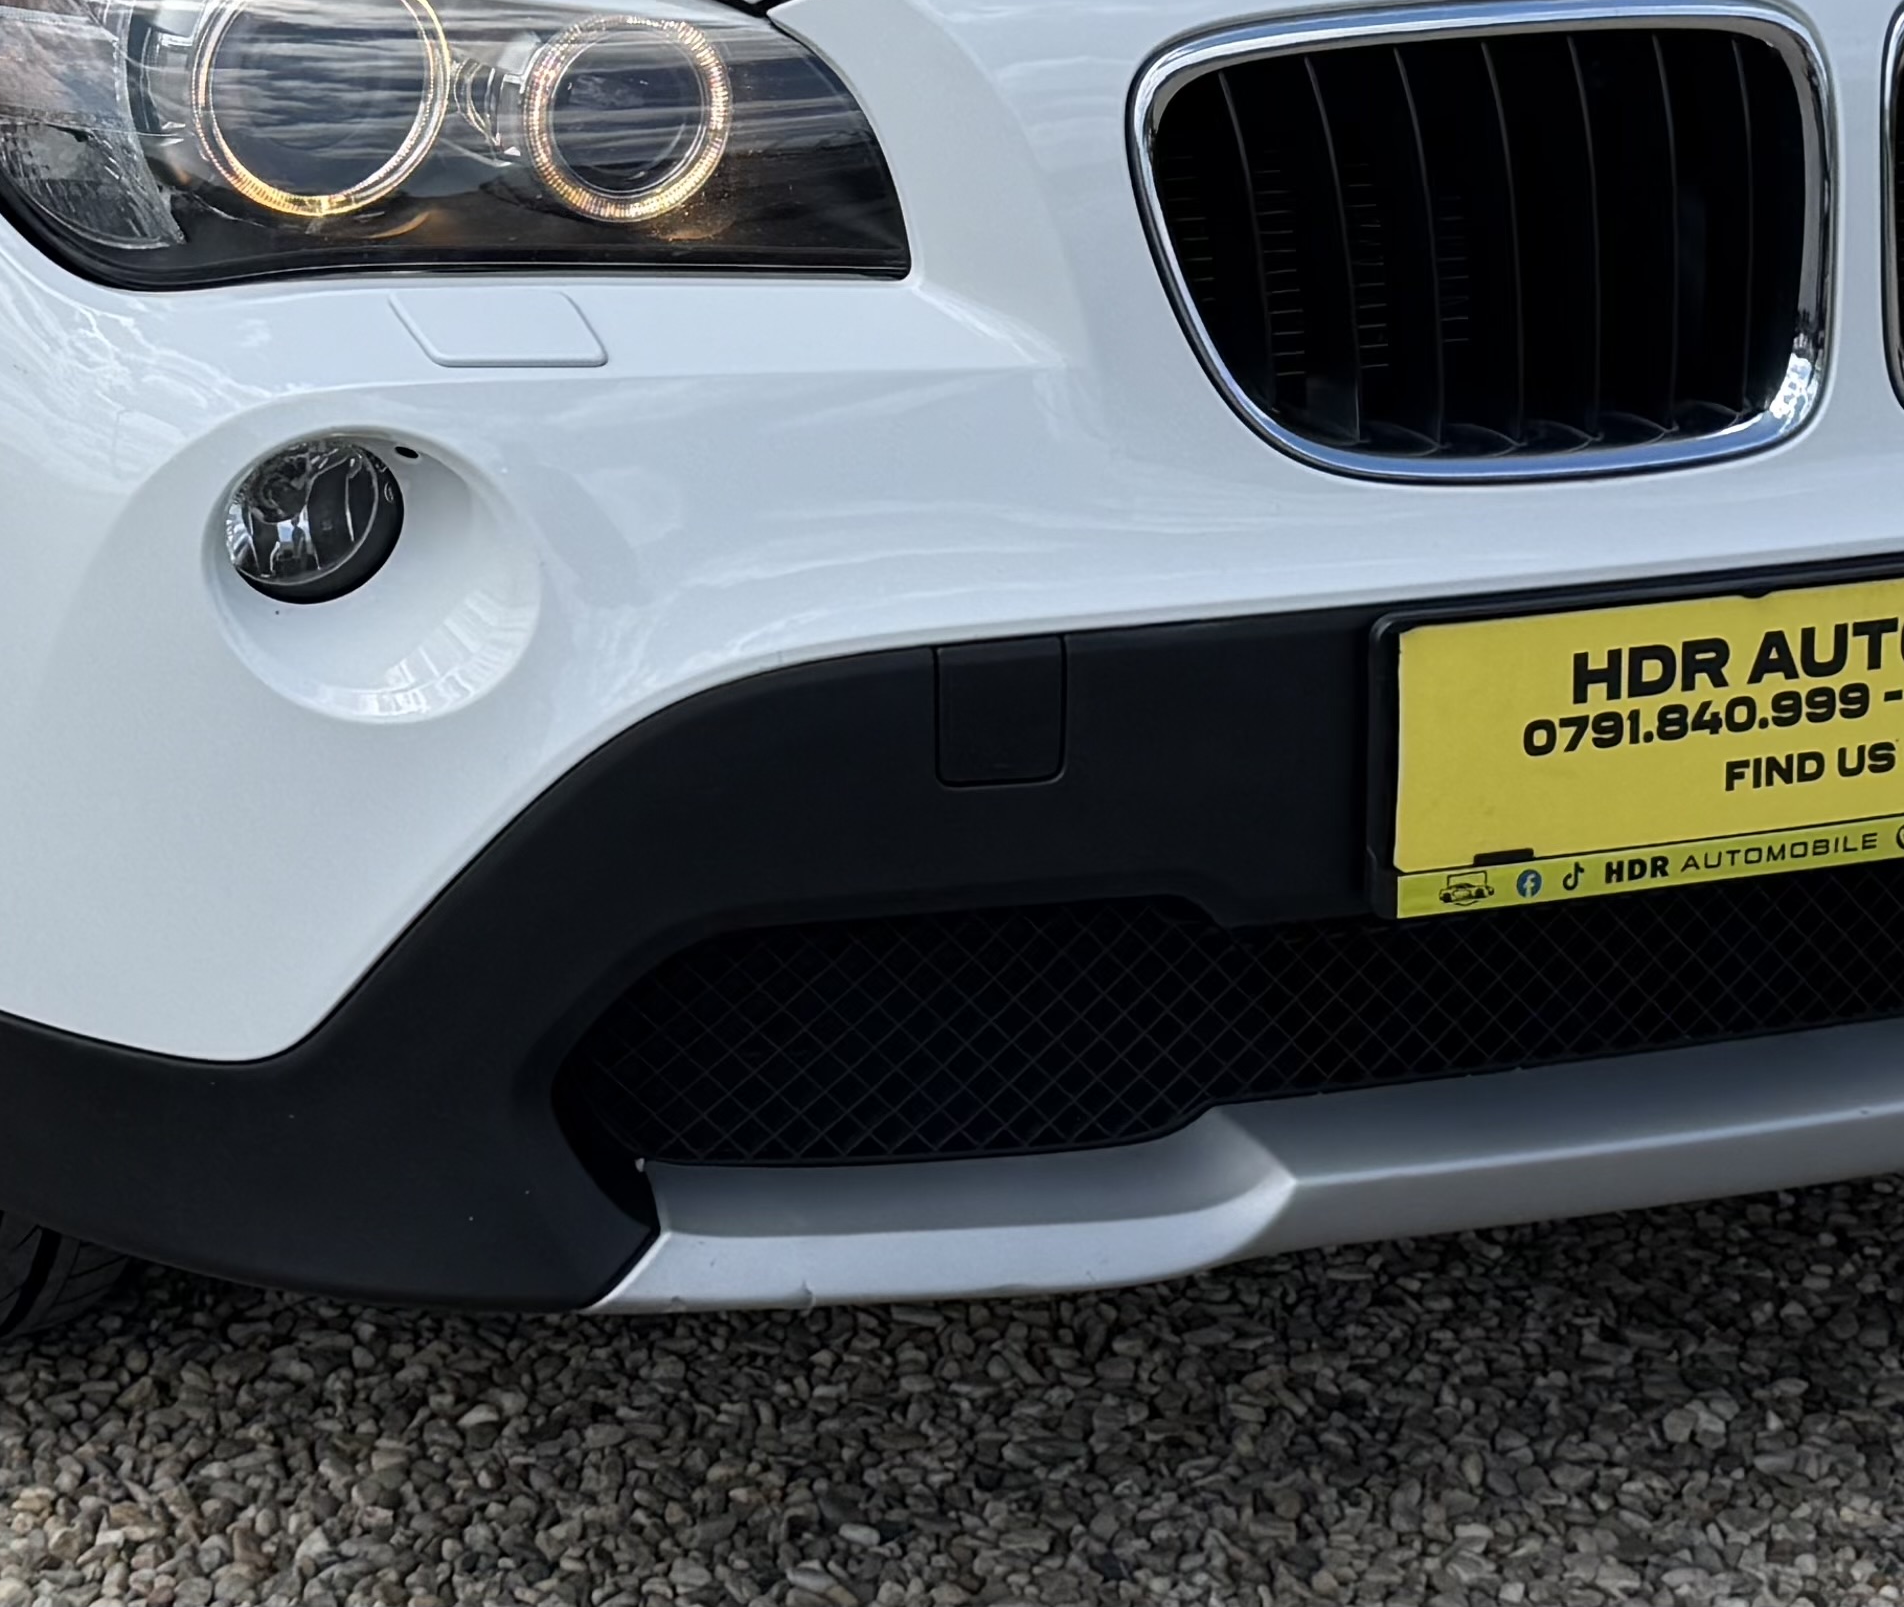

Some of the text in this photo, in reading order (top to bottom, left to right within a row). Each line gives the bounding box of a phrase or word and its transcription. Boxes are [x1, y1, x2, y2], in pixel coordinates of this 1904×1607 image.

[1573, 637, 1731, 705] HDR
[1523, 682, 1870, 756] 0791.840.999
[1725, 751, 1825, 791] FIND
[1837, 741, 1896, 777] US
[1605, 856, 1669, 884] HDR
[1680, 832, 1878, 872] AUTOMOBILE
